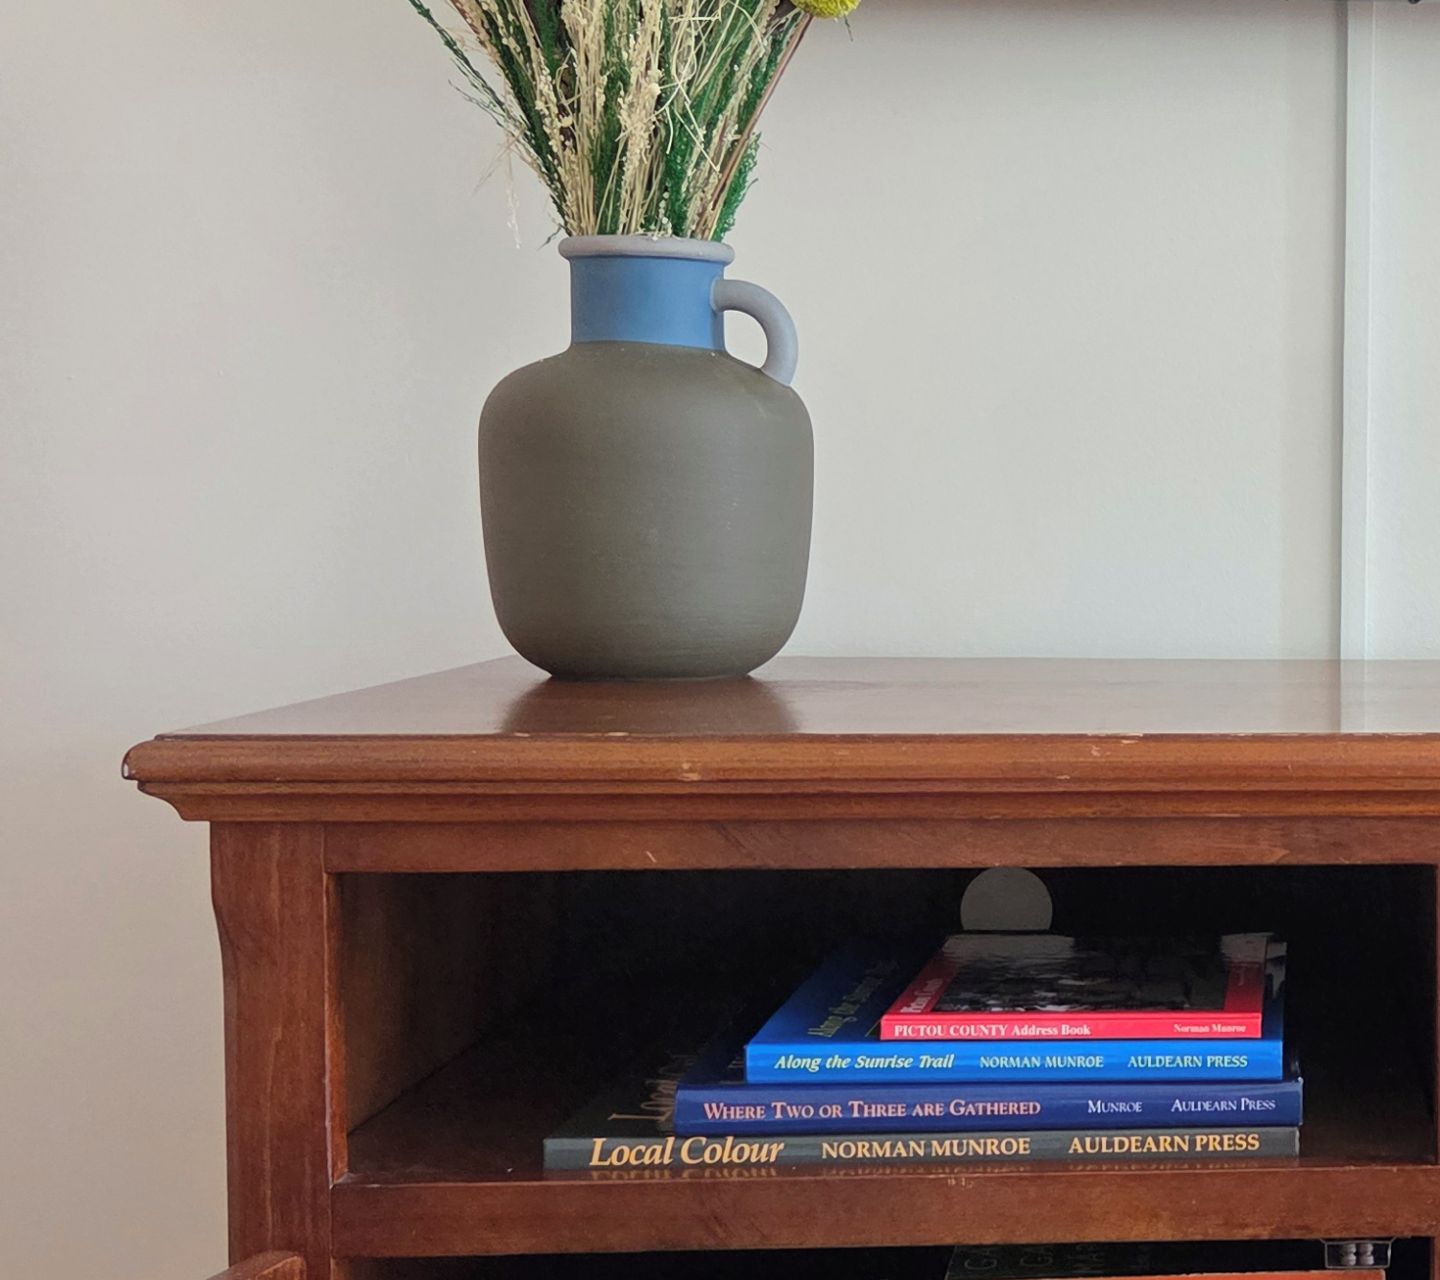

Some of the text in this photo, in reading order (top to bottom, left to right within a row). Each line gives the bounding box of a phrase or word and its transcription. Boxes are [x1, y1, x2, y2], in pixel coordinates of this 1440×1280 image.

[894, 1023, 1091, 1037] PICTOU COUNTY Address Book
[1174, 1023, 1246, 1033] Norman Munroe
[774, 1054, 955, 1073] Along the Sunrise Trail
[980, 1055, 1104, 1068] NORMAN MUNROE
[1128, 1055, 1248, 1068] AULDEARN PRESS
[703, 1098, 1041, 1120] WHERE TWO OR THREE ARE GATHERED
[1087, 1099, 1143, 1114] MUNROE
[1171, 1097, 1276, 1112] AULDEARN PRESS
[590, 1136, 784, 1166] Local Colour
[822, 1137, 1031, 1159] NORMAN MUNROE
[1068, 1133, 1260, 1154] AULDEARN PRESS
